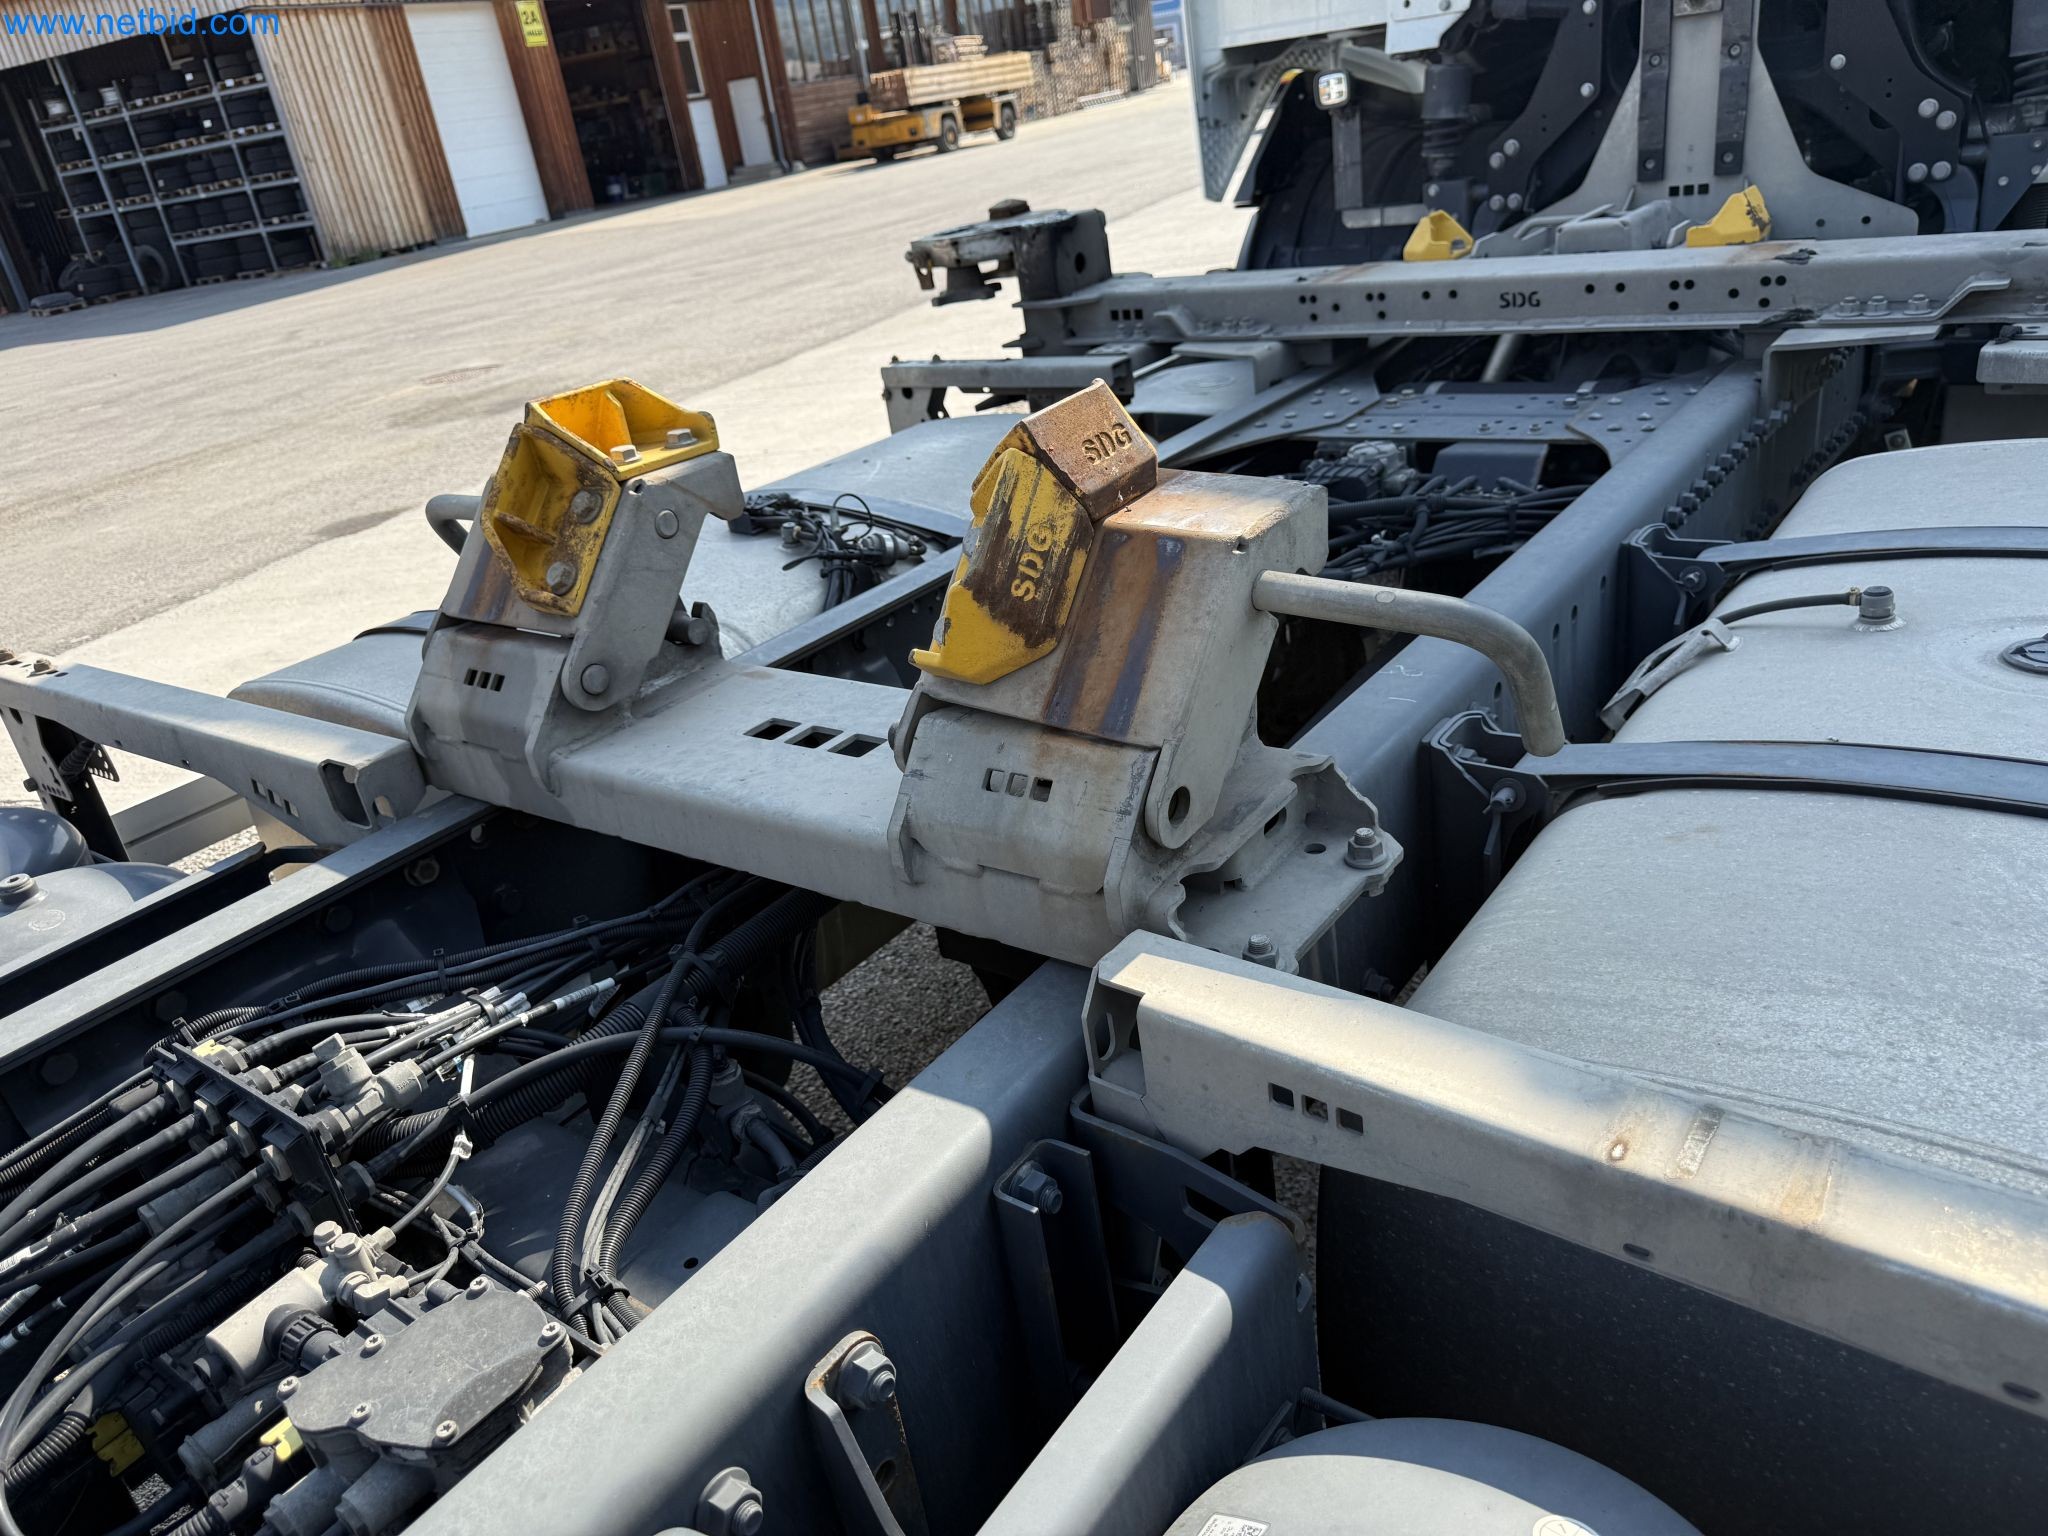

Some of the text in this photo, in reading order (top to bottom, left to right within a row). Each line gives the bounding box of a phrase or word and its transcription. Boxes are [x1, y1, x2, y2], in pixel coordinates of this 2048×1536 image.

[1500, 291, 1541, 309] SDG
[1082, 422, 1133, 464] SDG
[1010, 523, 1053, 602] SDG
